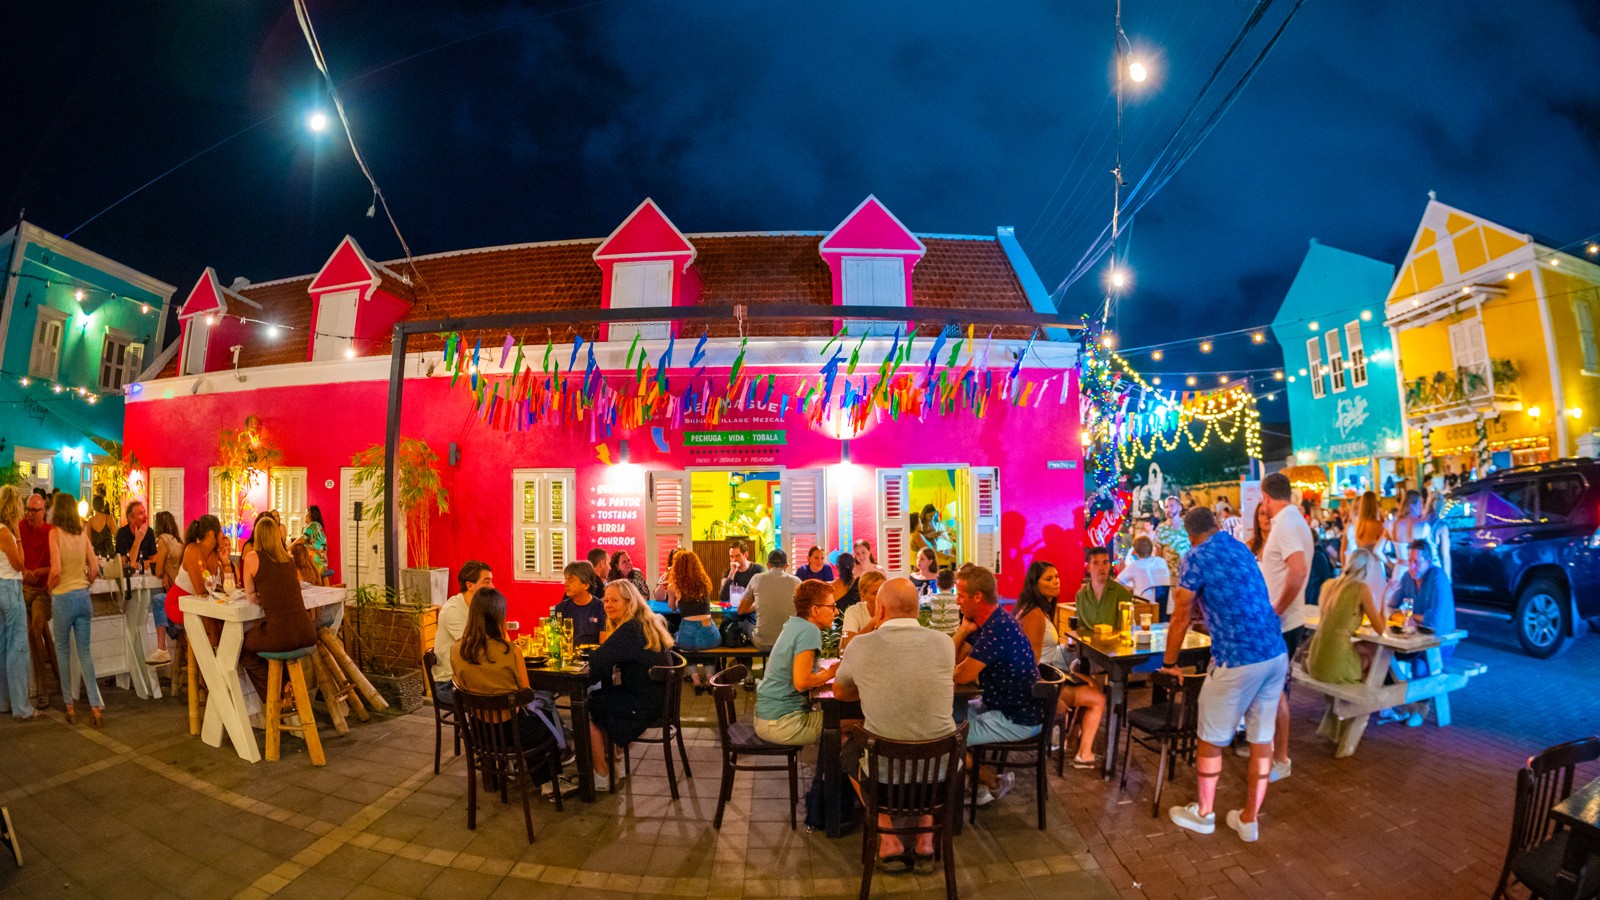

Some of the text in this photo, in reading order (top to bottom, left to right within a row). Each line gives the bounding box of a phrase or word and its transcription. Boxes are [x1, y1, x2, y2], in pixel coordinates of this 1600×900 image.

[1446, 421, 1508, 441] COCKILS
[690, 433, 779, 442] PECHUGA VIDA TOBALA
[609, 497, 641, 507] PASTOR
[597, 510, 638, 519] TOSTADAS
[597, 523, 626, 533] BIRRIA
[597, 536, 636, 546] CHURROS
